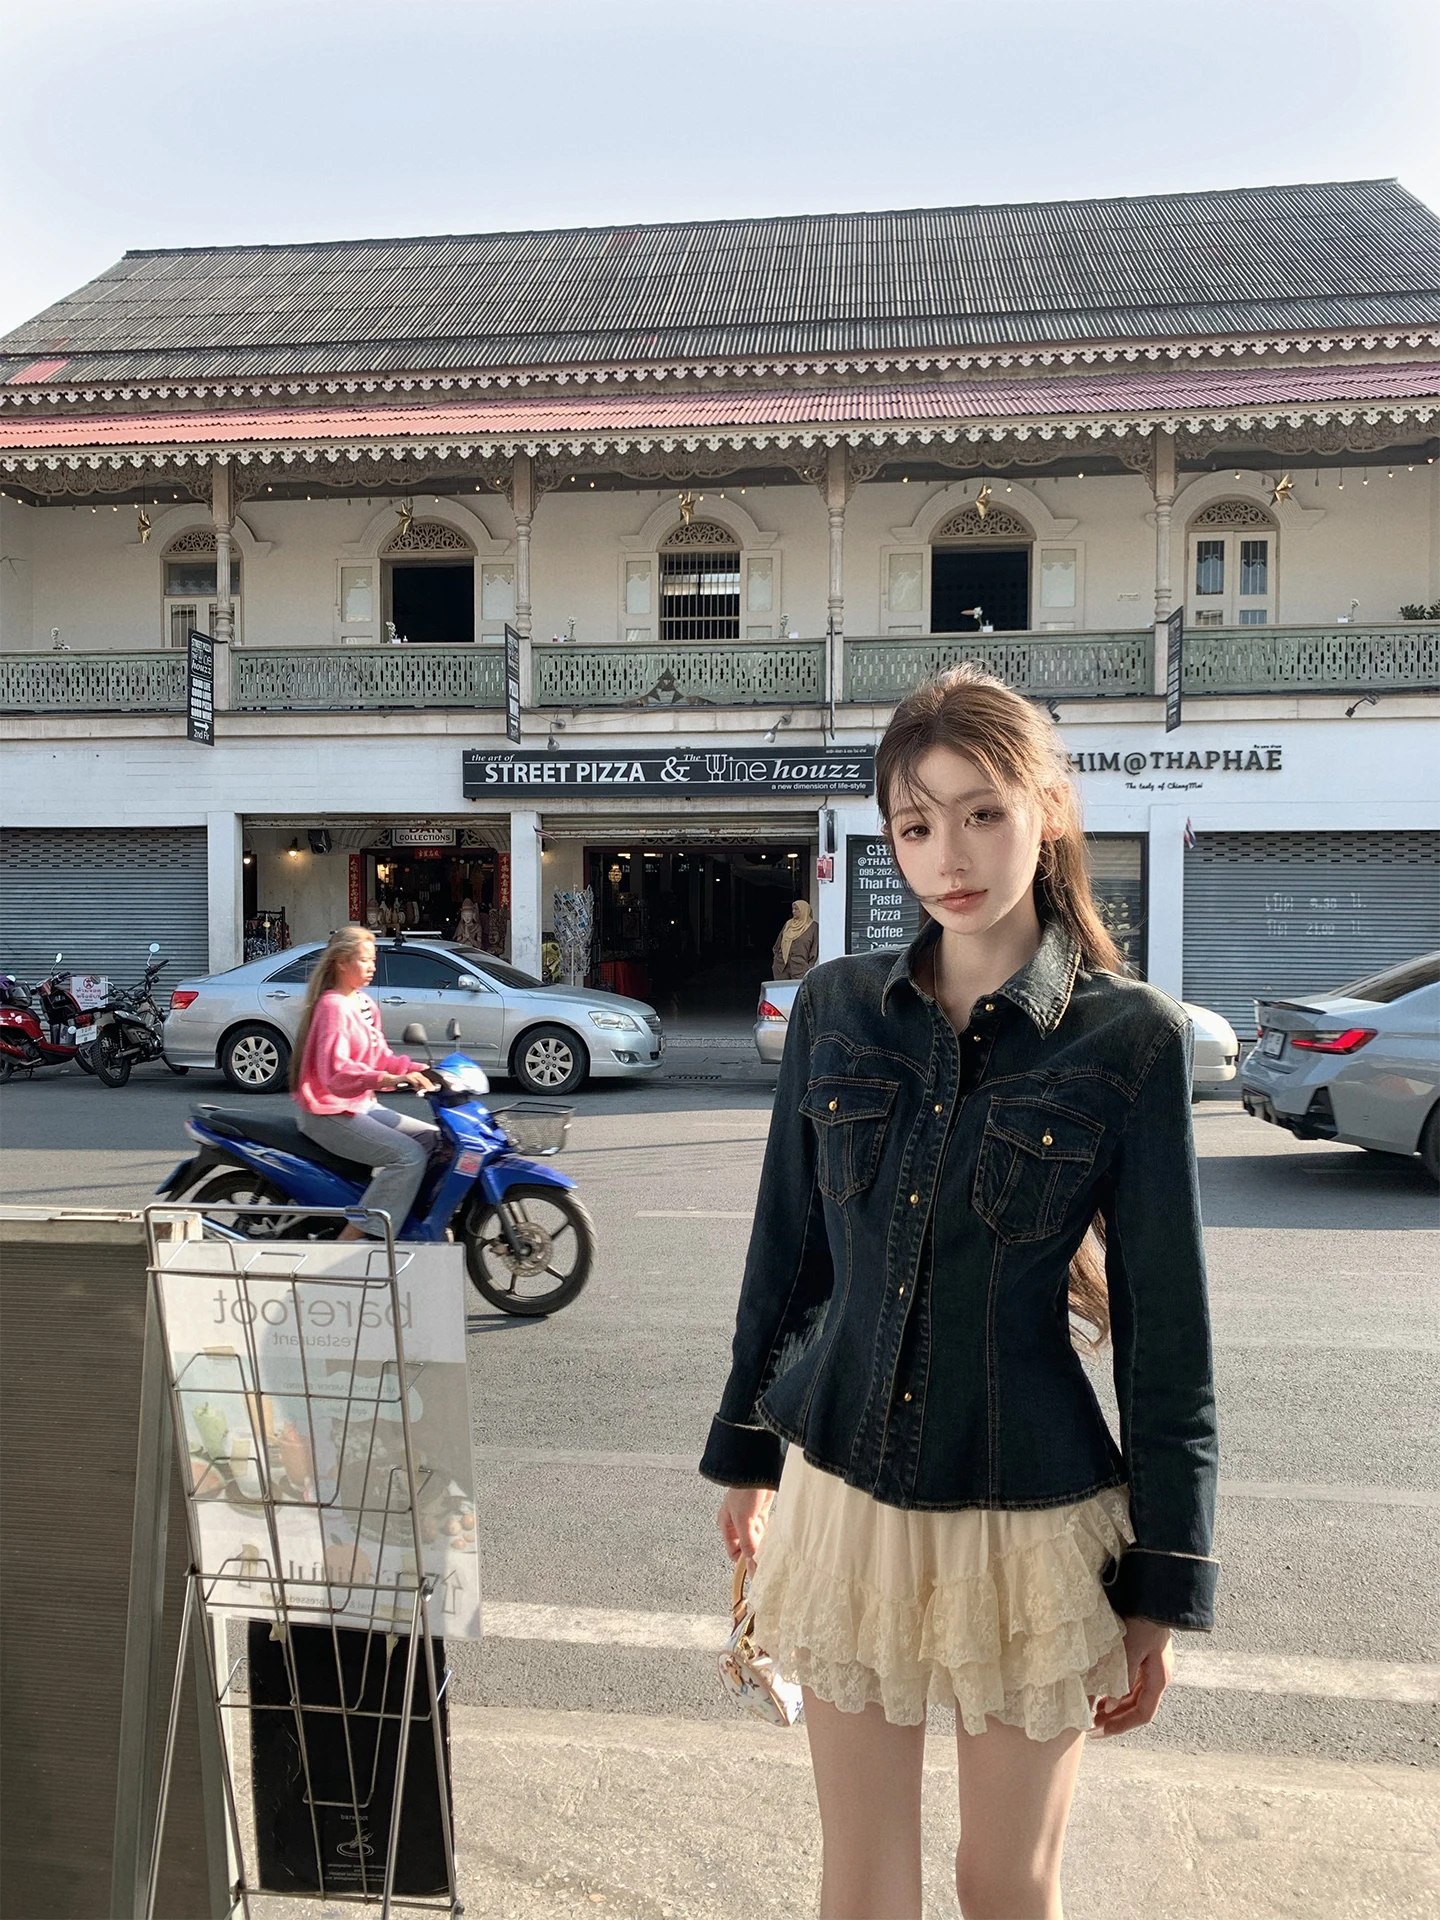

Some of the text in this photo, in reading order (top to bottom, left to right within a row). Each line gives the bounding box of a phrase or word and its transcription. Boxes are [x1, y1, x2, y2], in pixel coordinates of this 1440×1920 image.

[193, 729, 203, 739] 2nd
[471, 753, 515, 763] the art of
[1067, 749, 1283, 776] HIM@THAPHAE
[485, 754, 861, 783] STREET PIZZA & The Wine houzz
[793, 782, 829, 790] dimension
[838, 782, 867, 792] life-style
[1157, 782, 1166, 791] of
[866, 844, 892, 856] CH
[857, 856, 895, 867] @THAP
[859, 868, 899, 876] 099-262-
[858, 877, 903, 890] Thai Fo
[869, 893, 903, 906] Pasta
[870, 908, 901, 922] Pizza
[866, 925, 904, 939] Coffee
[340, 1814, 369, 1822] bareoot
